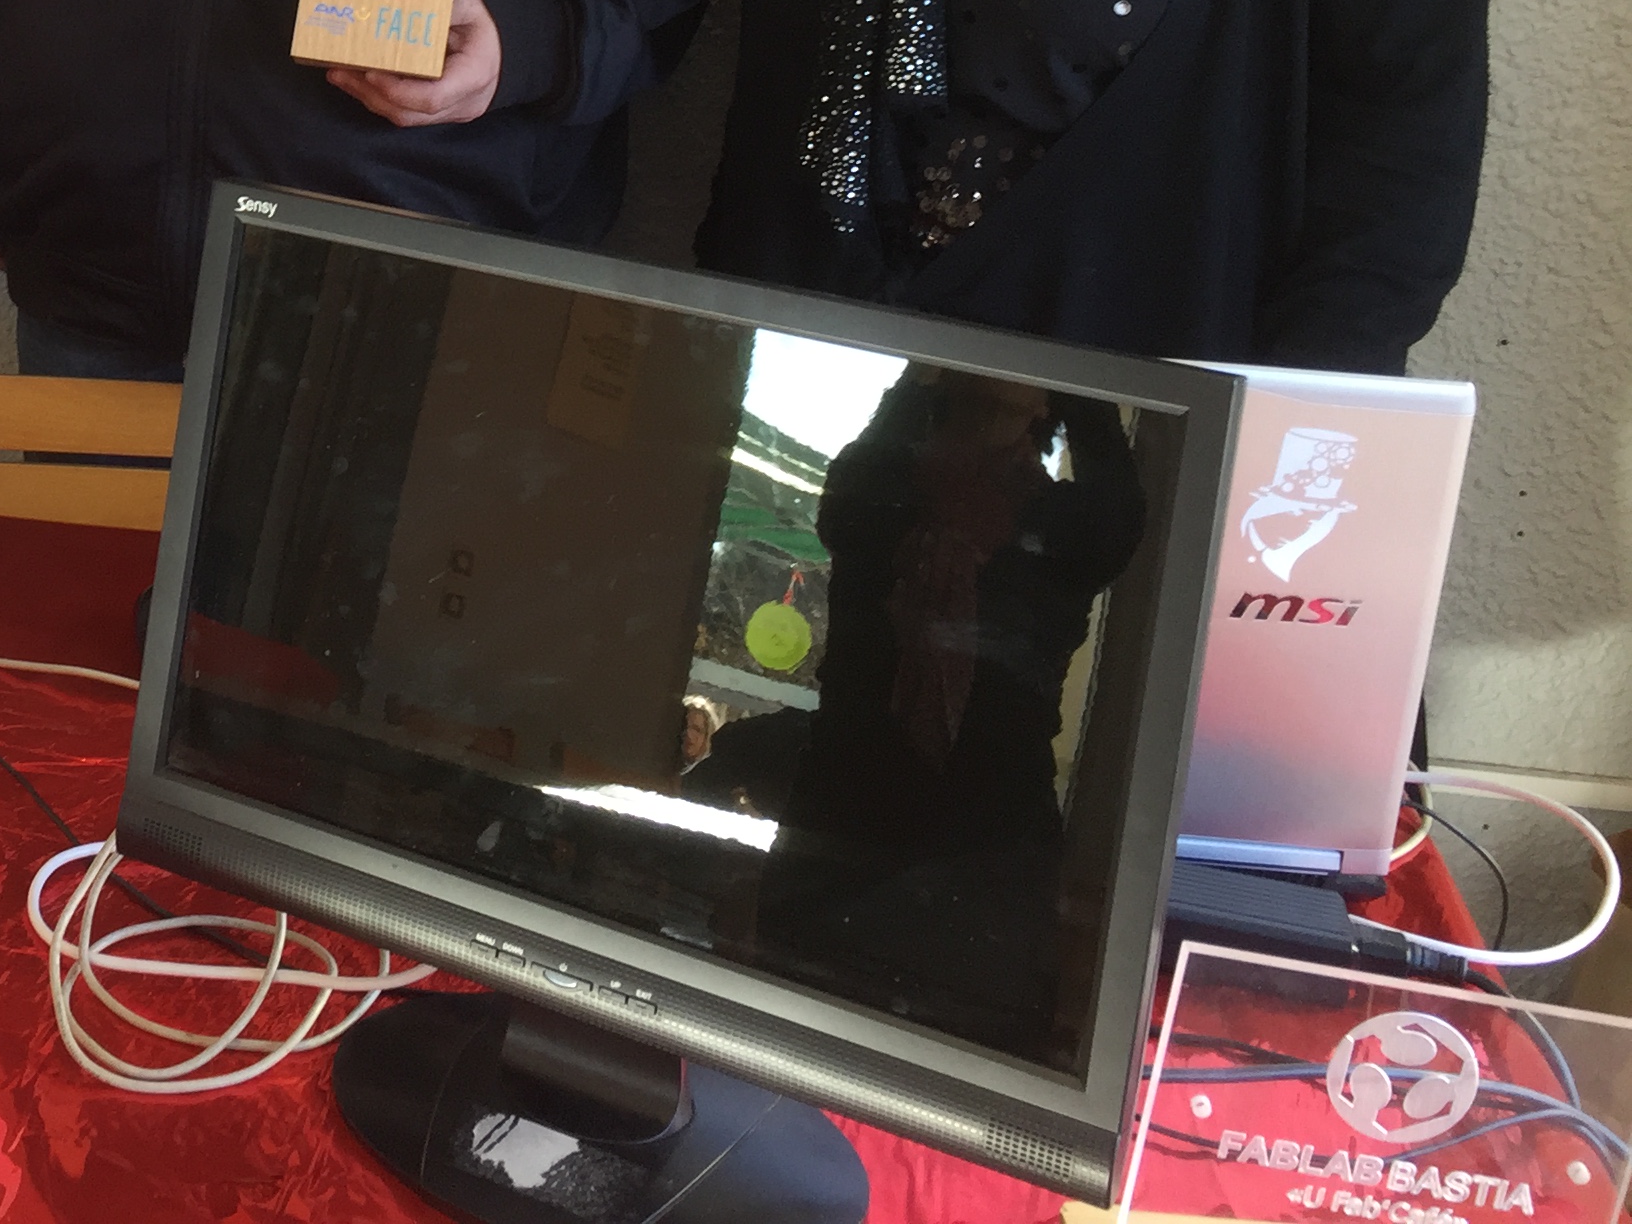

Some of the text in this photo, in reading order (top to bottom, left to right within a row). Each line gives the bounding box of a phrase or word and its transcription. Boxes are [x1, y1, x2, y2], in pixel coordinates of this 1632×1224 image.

[374, 5, 438, 47] FACE
[234, 196, 278, 218] Sensy
[1229, 591, 1364, 627] msi
[475, 932, 653, 1001] MENU DOWN UP EXIT
[1217, 1129, 1535, 1217] FABLAB BASTIA
